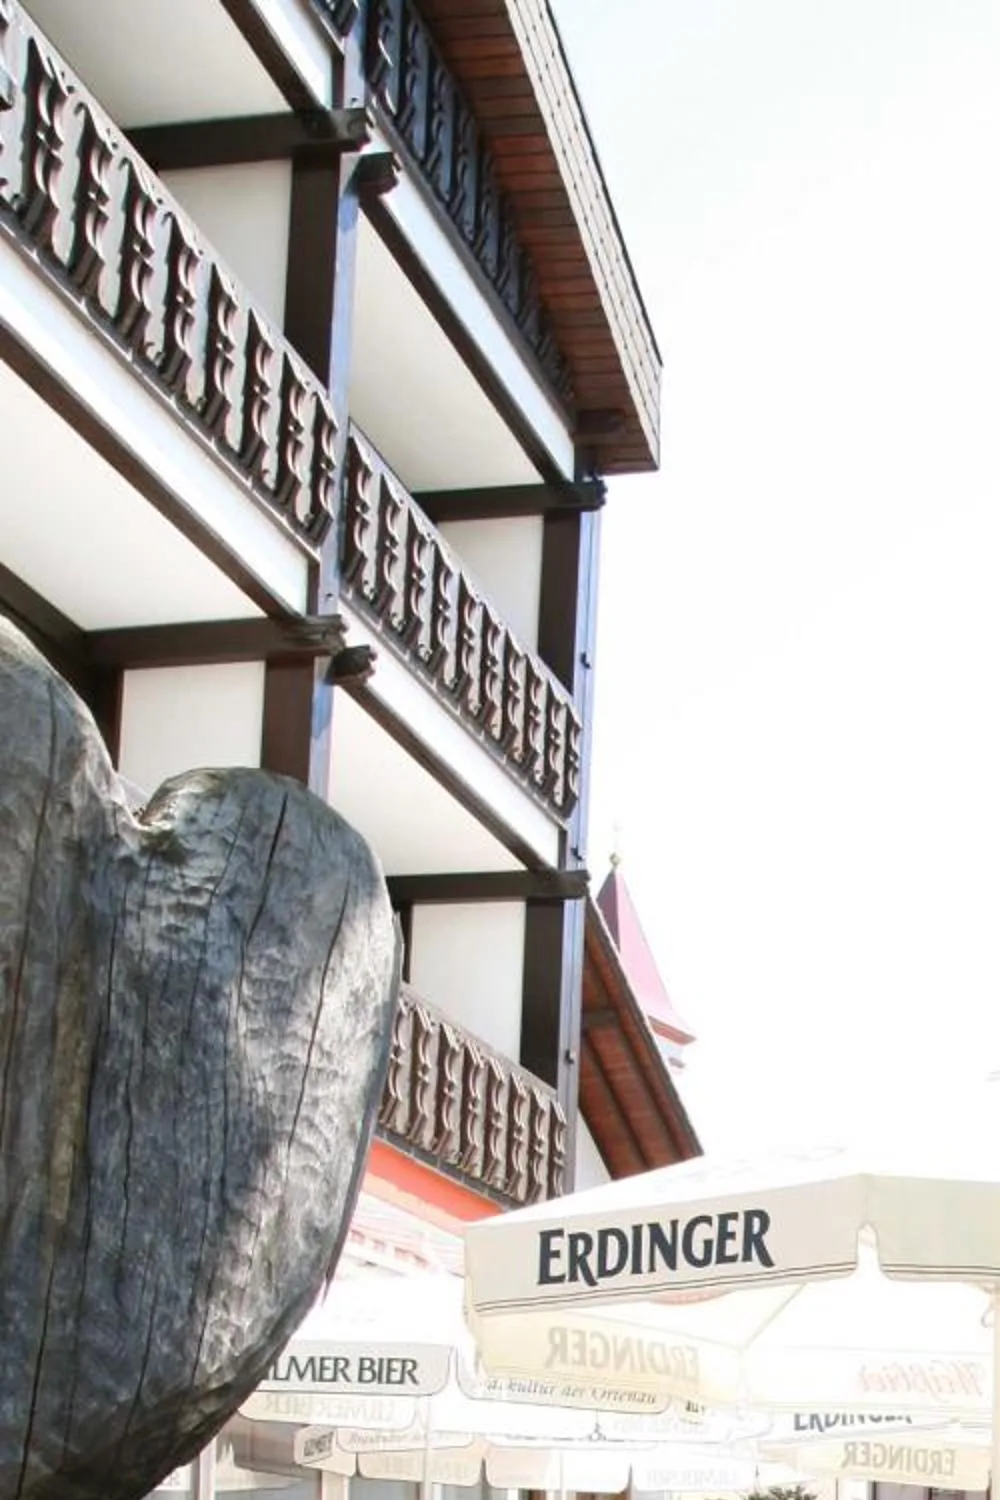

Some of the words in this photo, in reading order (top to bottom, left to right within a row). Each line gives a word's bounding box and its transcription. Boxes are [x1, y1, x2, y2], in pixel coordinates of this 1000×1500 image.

[536, 1208, 775, 1287] ERDINGER
[268, 1355, 352, 1383] LMER
[357, 1356, 420, 1386] BIER
